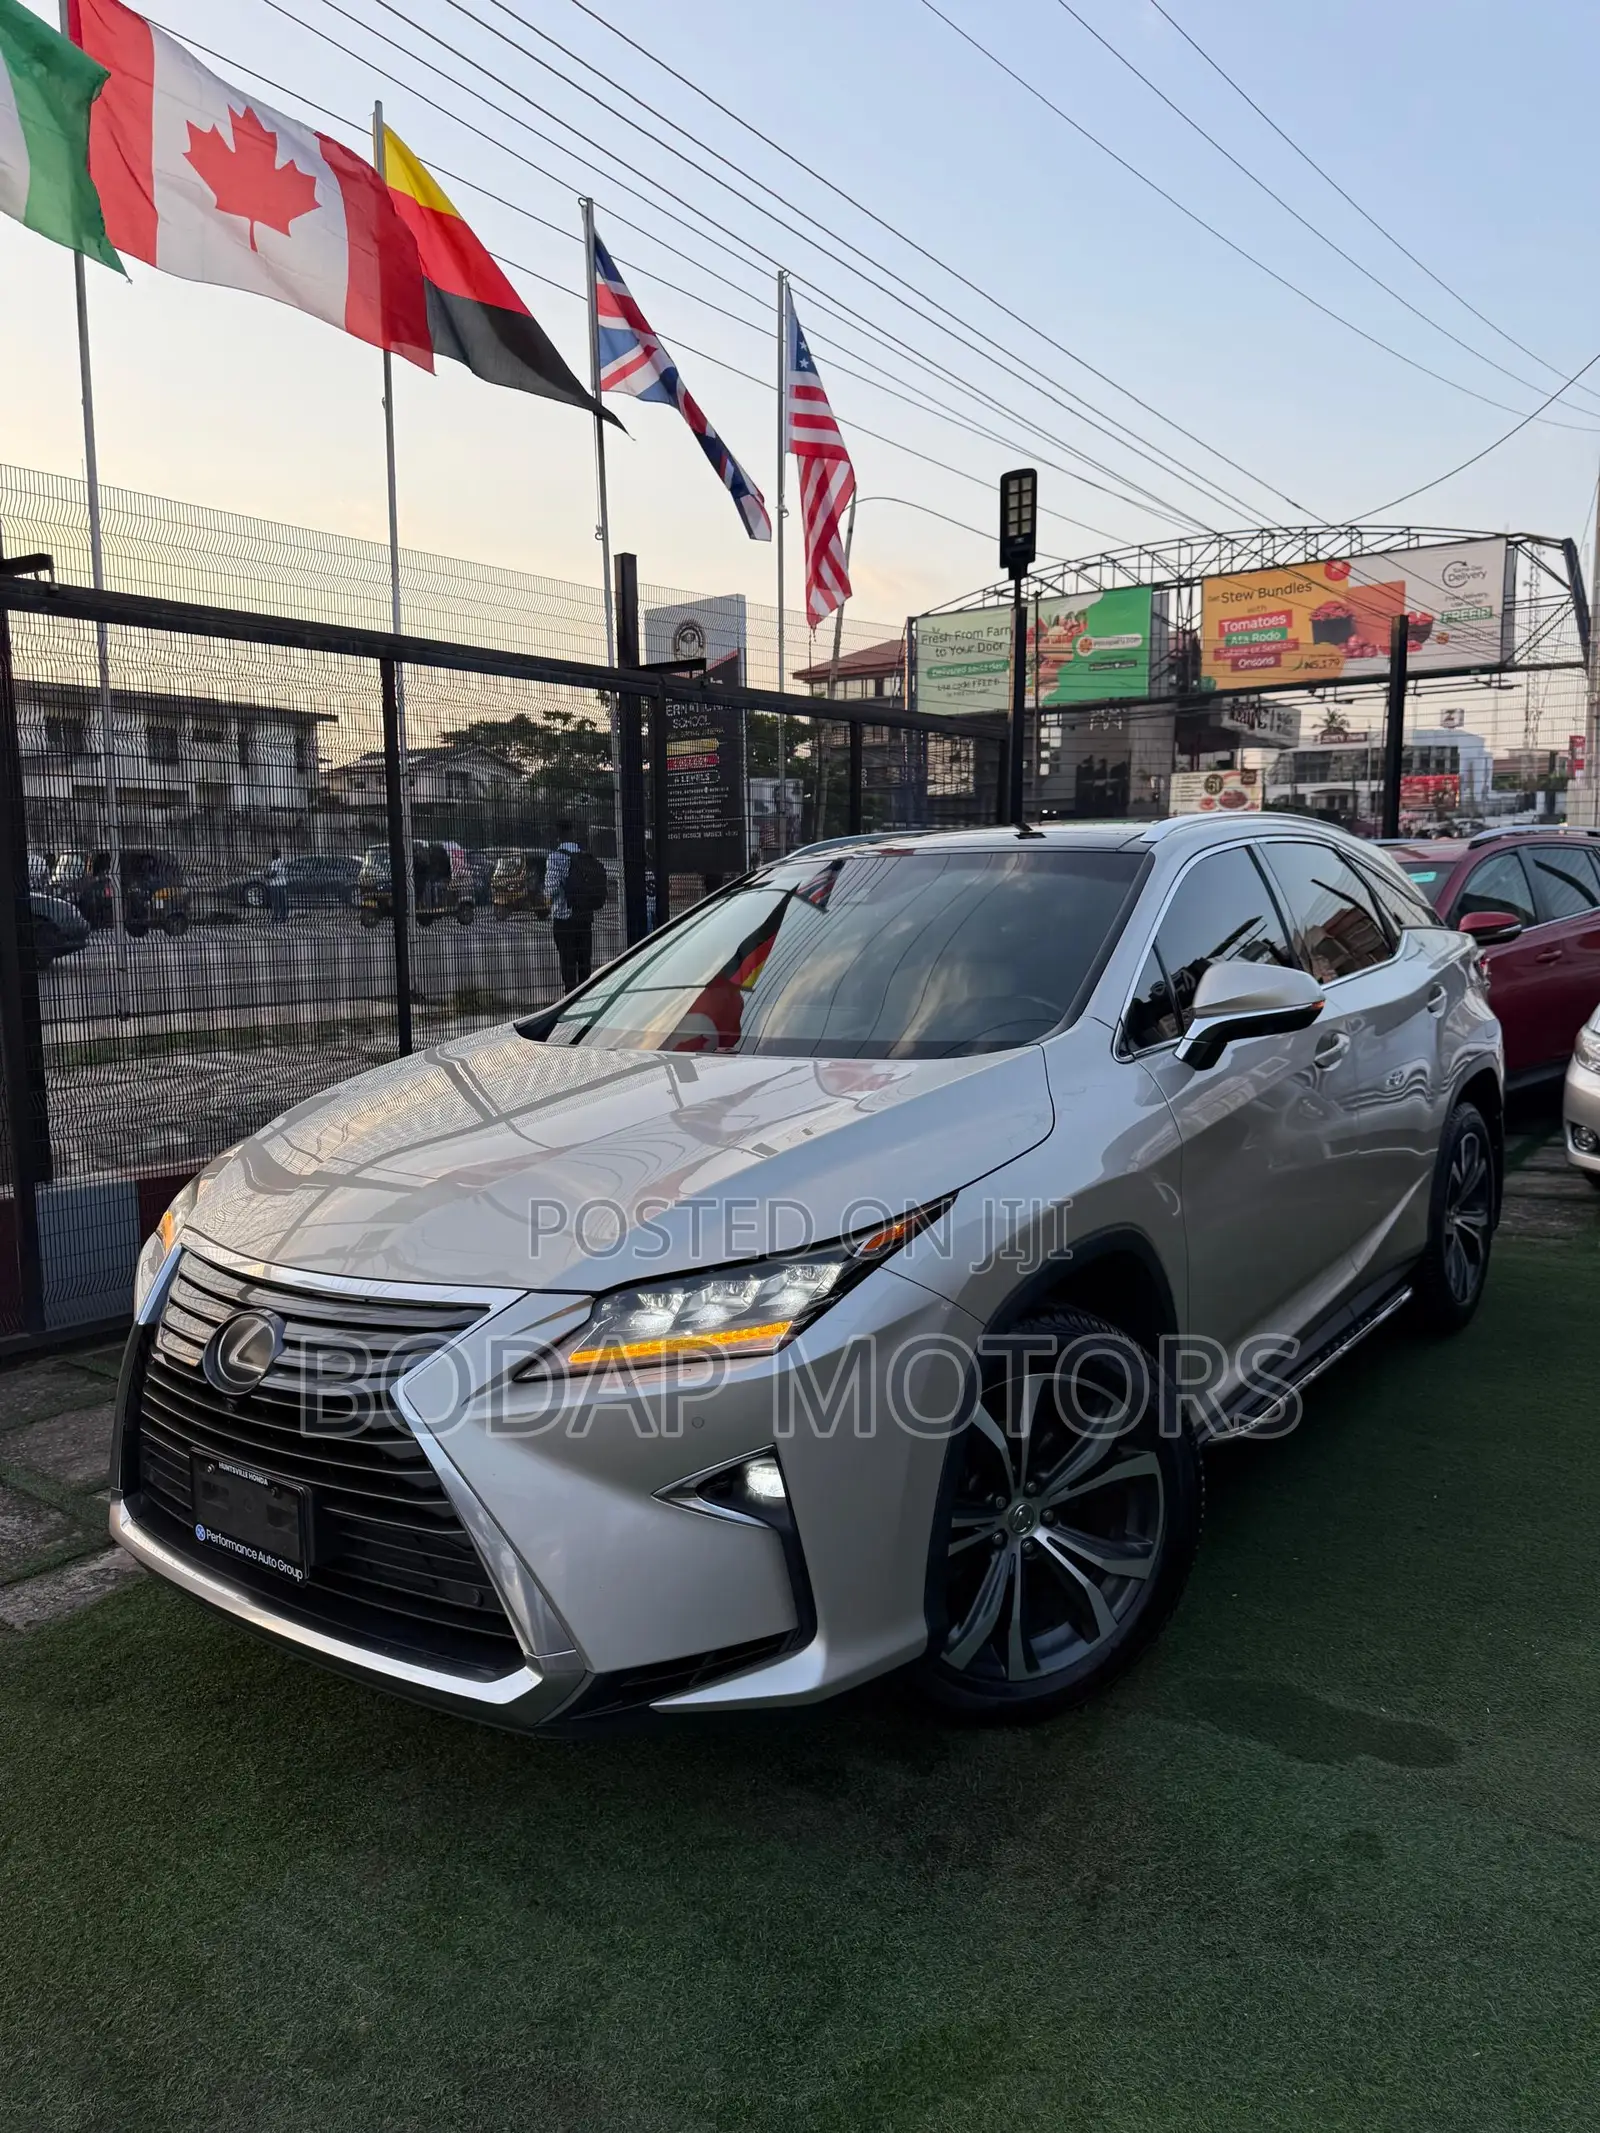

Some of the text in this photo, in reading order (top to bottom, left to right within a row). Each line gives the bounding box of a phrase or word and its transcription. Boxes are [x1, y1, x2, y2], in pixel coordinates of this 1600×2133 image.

[1447, 570, 1488, 582] Delivery
[1221, 590, 1254, 604] Stew
[1258, 581, 1313, 599] Bundles
[1222, 613, 1287, 633] Tomatoes
[921, 632, 951, 645] Fresh
[954, 629, 984, 641] From
[1252, 629, 1282, 643] Rodo
[935, 642, 1004, 658] to Your Door
[1238, 655, 1275, 669] Onions
[218, 1462, 269, 1486] HUNTSVILLE HONDA
[206, 1529, 304, 1582] Performance Auto Group
